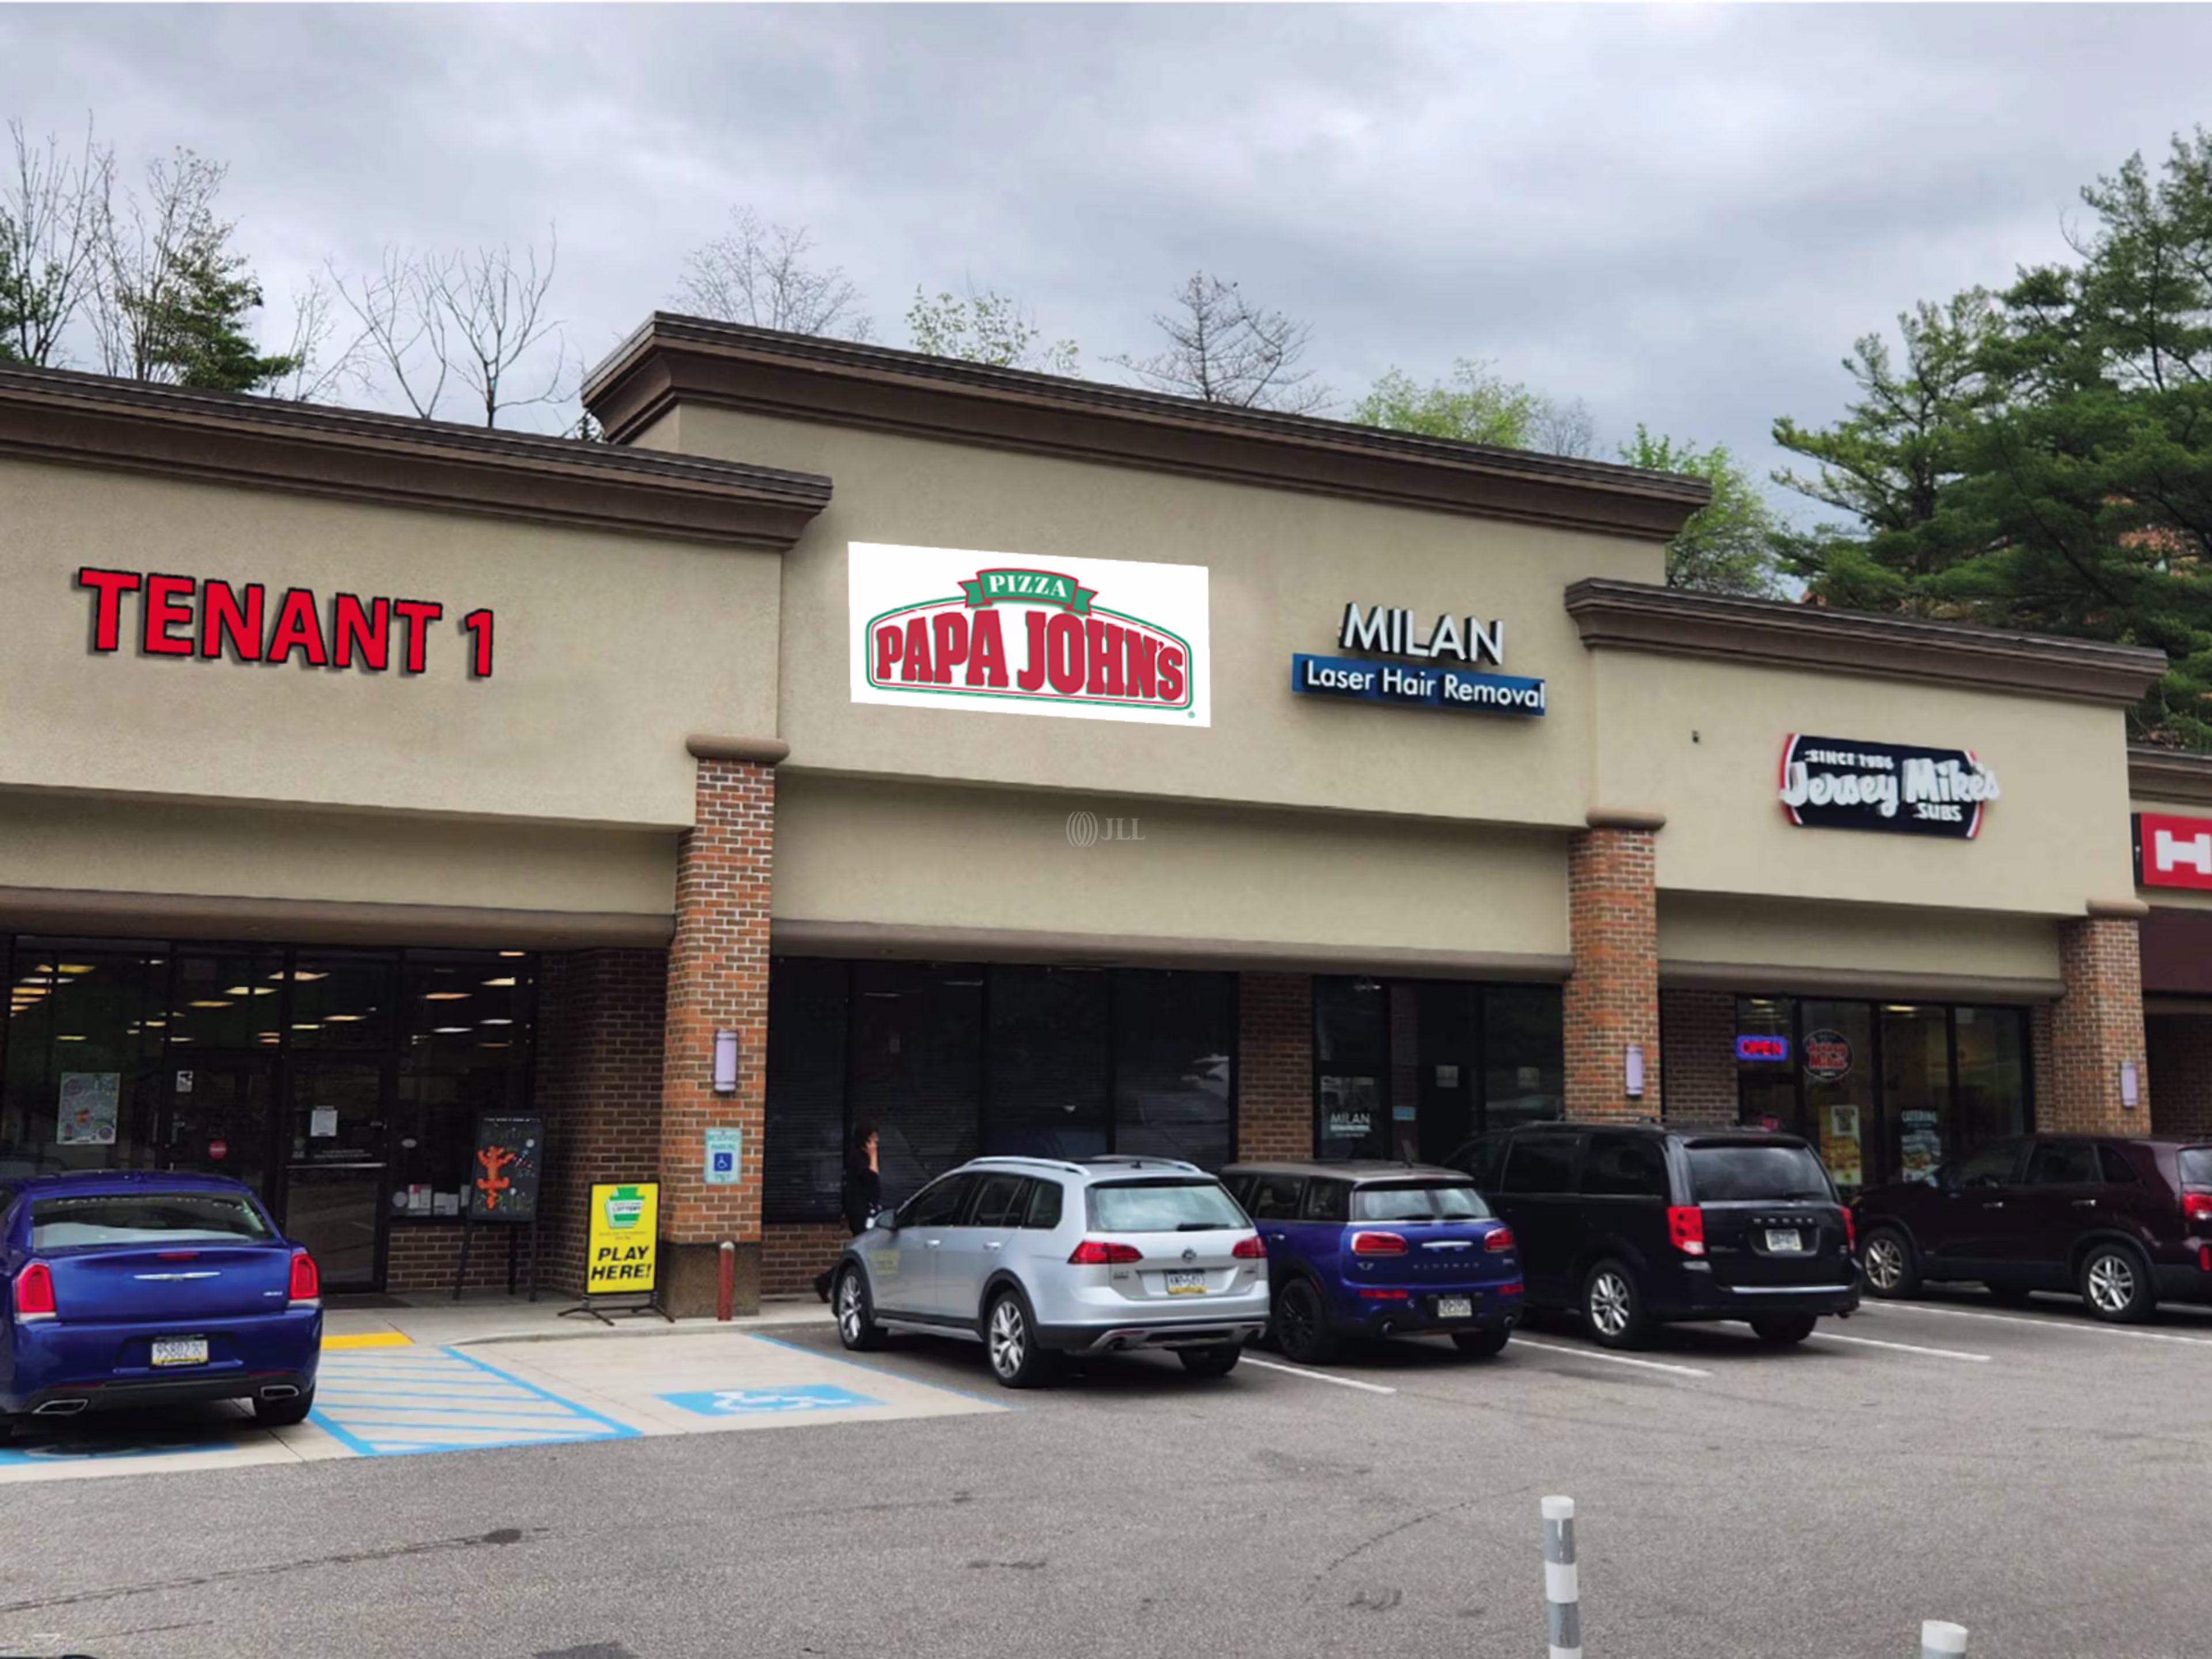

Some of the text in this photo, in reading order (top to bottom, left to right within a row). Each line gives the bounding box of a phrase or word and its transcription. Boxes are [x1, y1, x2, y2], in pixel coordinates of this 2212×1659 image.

[988, 574, 1067, 599] PIZZA
[78, 566, 494, 677] TENANT 1
[1340, 601, 1503, 665] MILAN
[876, 609, 1184, 701] PAPA JOHN'S
[1306, 660, 1545, 709] Laser Hair Removal
[1805, 749, 1855, 766] SINCE
[1780, 762, 1899, 817] Jersey
[1914, 803, 1963, 821] SUBS
[1741, 1040, 1783, 1055] OPEN
[1330, 1112, 1370, 1124] MILAN
[1902, 1110, 1937, 1123] CATERING
[597, 1245, 650, 1262] PLAY
[590, 1263, 652, 1281] HERE!
